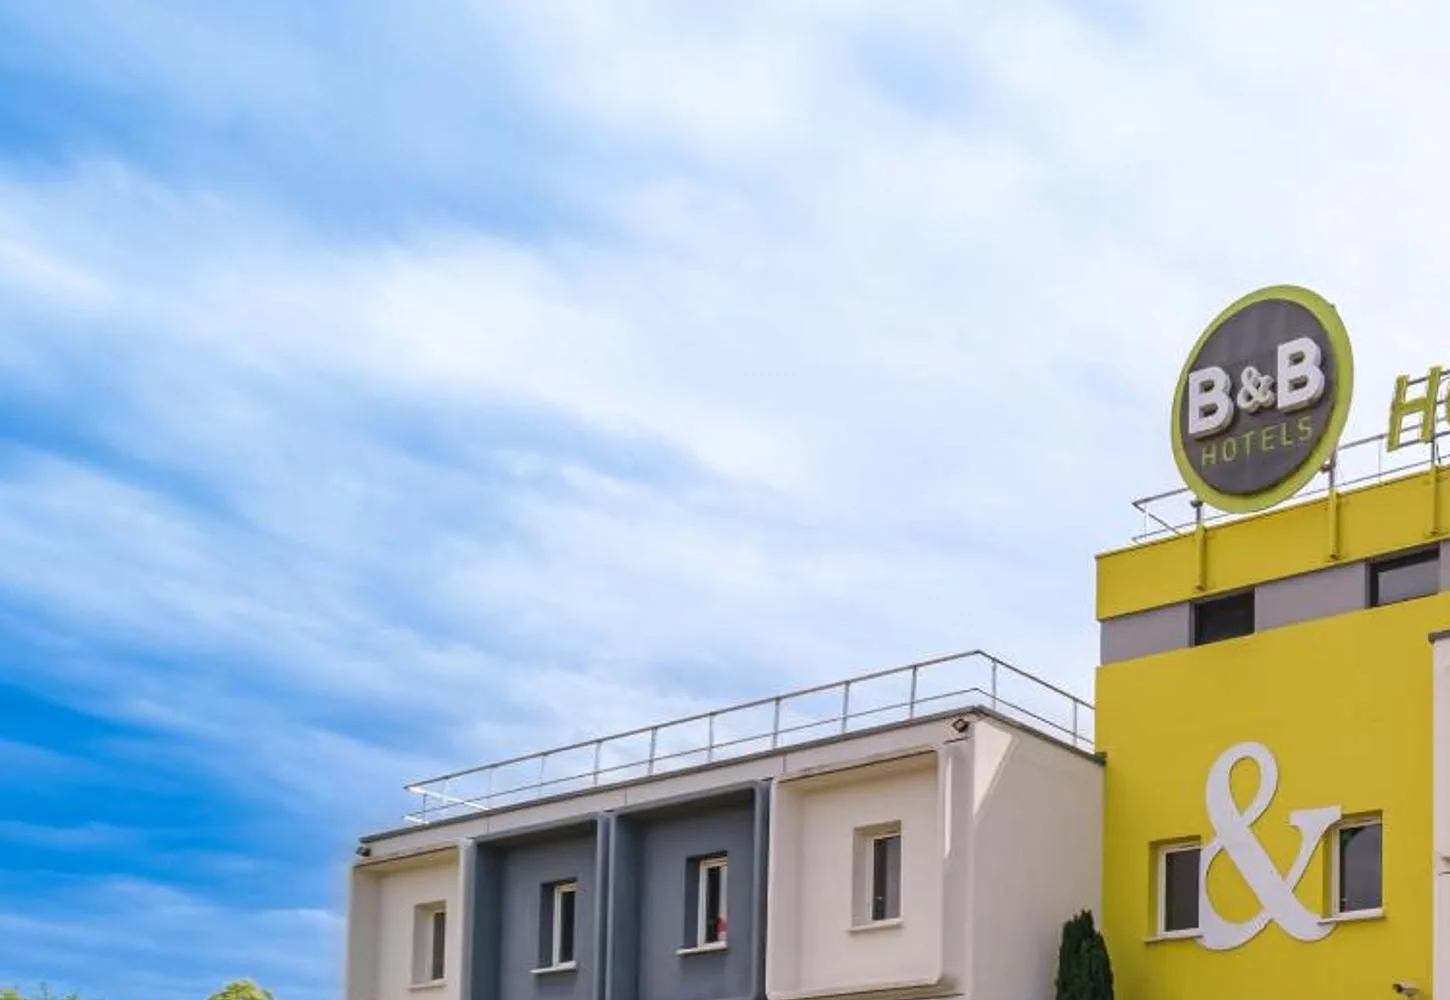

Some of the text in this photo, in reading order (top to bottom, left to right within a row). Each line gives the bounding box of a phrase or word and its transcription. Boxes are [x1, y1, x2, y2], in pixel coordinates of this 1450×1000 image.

[1187, 336, 1327, 438] B&B
[1201, 414, 1314, 467] HOTELS
[1196, 741, 1342, 950] &
